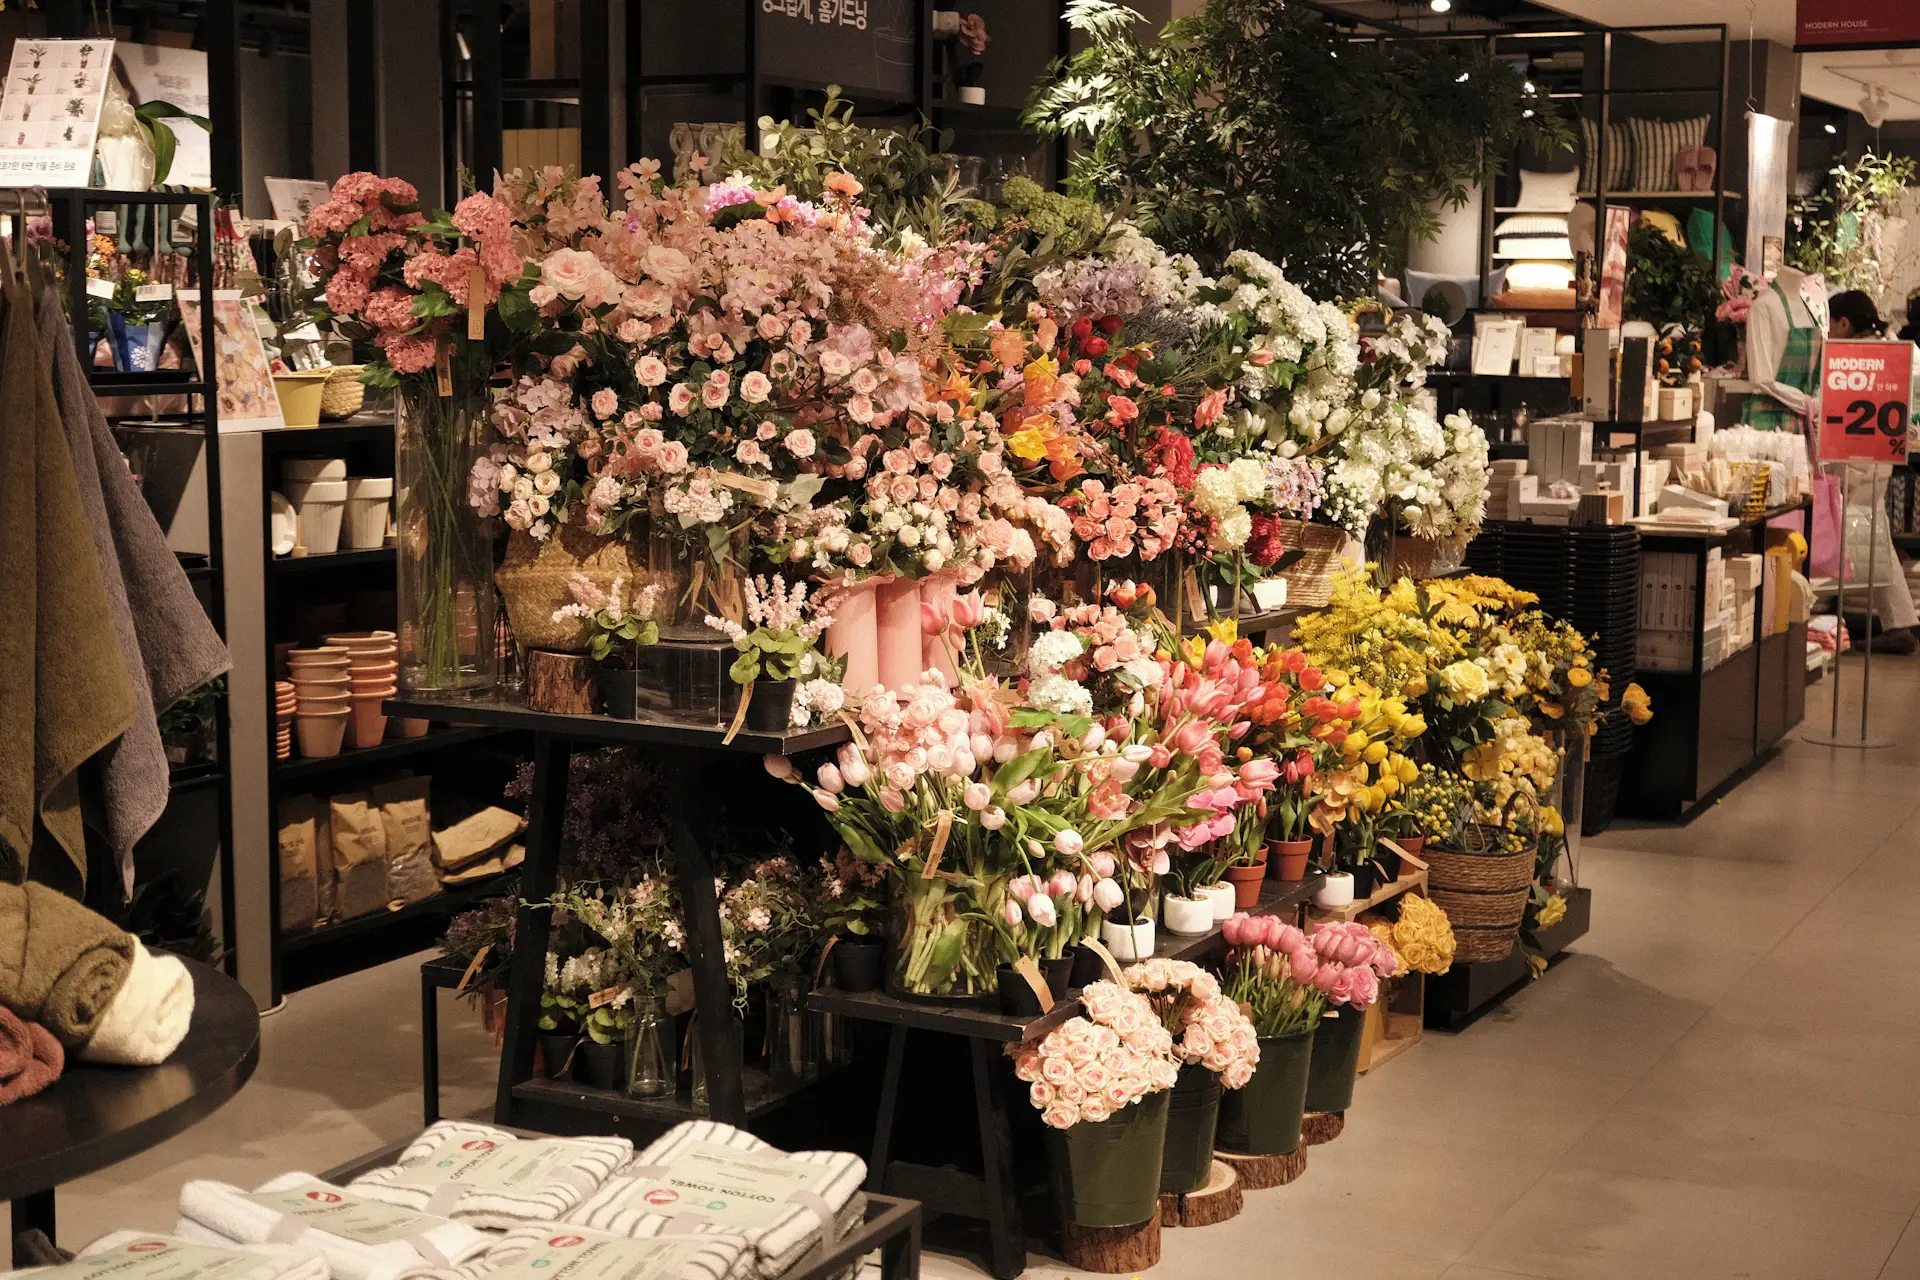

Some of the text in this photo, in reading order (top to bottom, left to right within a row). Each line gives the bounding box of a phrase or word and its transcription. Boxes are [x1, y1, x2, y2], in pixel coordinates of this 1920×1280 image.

[818, 0, 867, 30] 홈가드닝
[1804, 20, 1869, 29] MODERN HOUSE
[1828, 358, 1884, 371] MODERN
[1827, 372, 1876, 391] GO!
[1826, 399, 1908, 437] -20
[1889, 438, 1906, 456] %
[669, 1178, 715, 1193] TOWEL
[720, 1188, 776, 1204] COTTON
